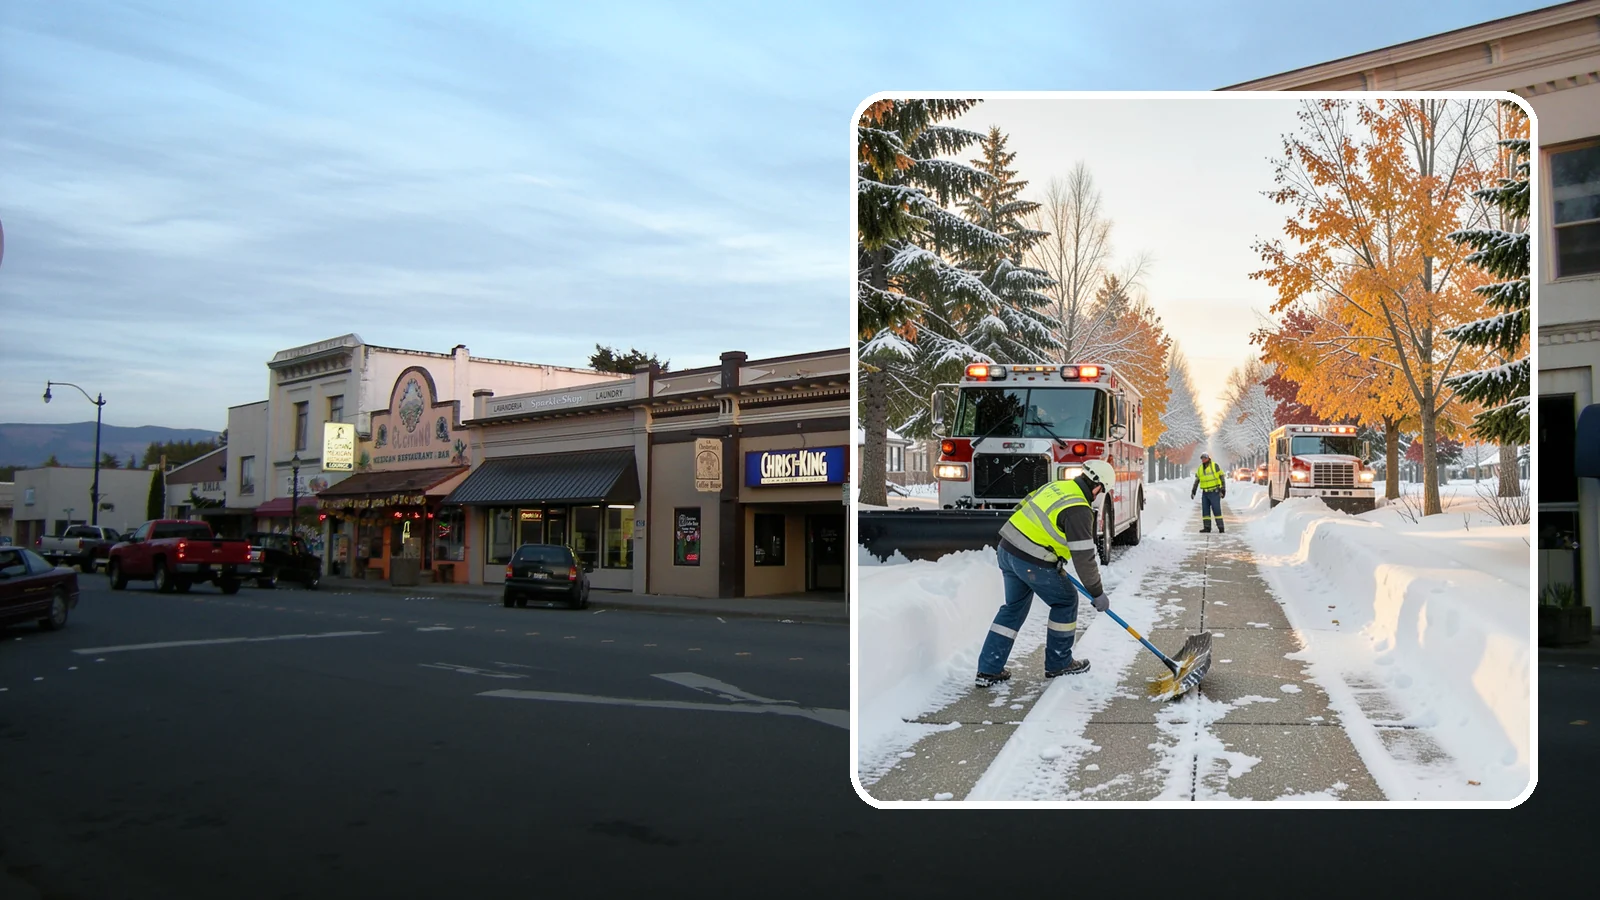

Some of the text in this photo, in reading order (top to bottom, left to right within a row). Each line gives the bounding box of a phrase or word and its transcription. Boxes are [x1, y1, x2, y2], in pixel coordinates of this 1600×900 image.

[596, 388, 624, 400] LAUNDRY
[494, 402, 522, 412] LAVANDERIA
[373, 450, 450, 464] MEXICAN RESTAURANT BAR
[761, 450, 827, 478] CHRIST KING
[696, 480, 709, 489] Coffee
